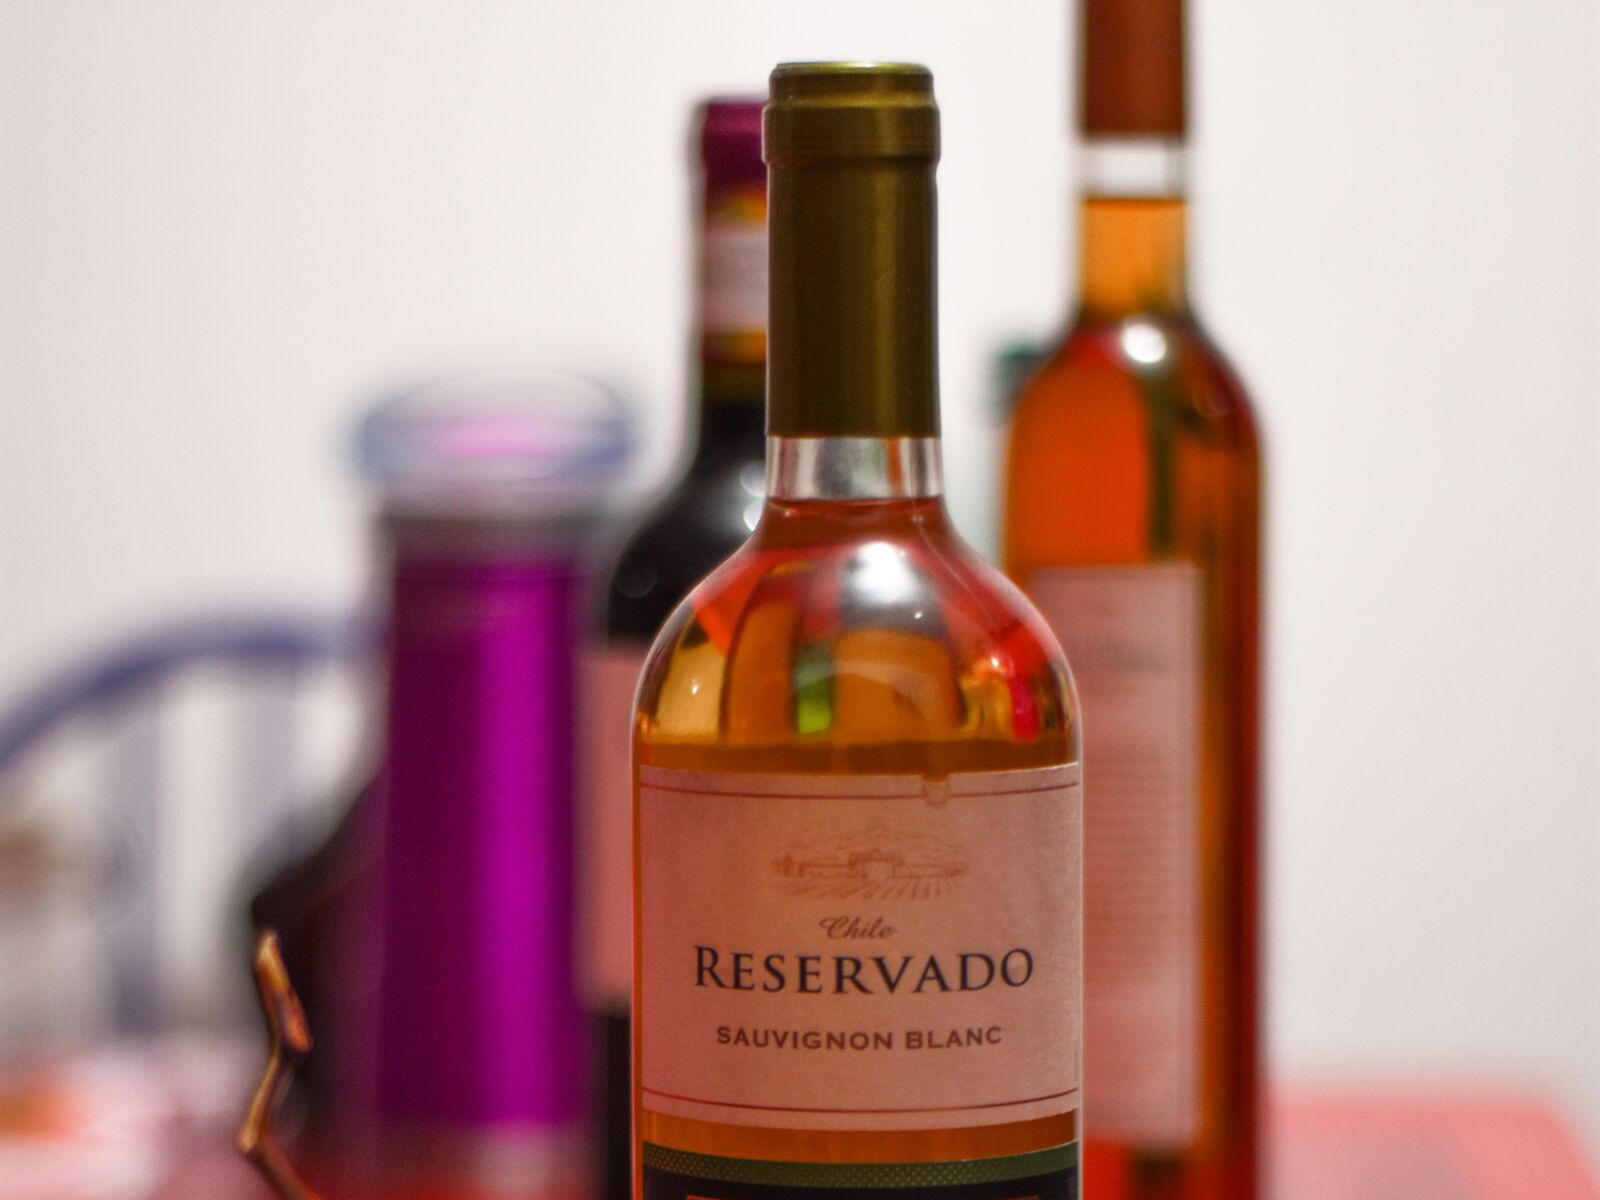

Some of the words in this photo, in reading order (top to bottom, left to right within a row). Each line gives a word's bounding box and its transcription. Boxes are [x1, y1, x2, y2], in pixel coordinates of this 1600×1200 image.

[819, 915, 897, 940] Chile
[693, 945, 1035, 995] RESERVADO
[716, 1026, 894, 1051] SAUVIGNON
[905, 1026, 1003, 1050] BLANC
